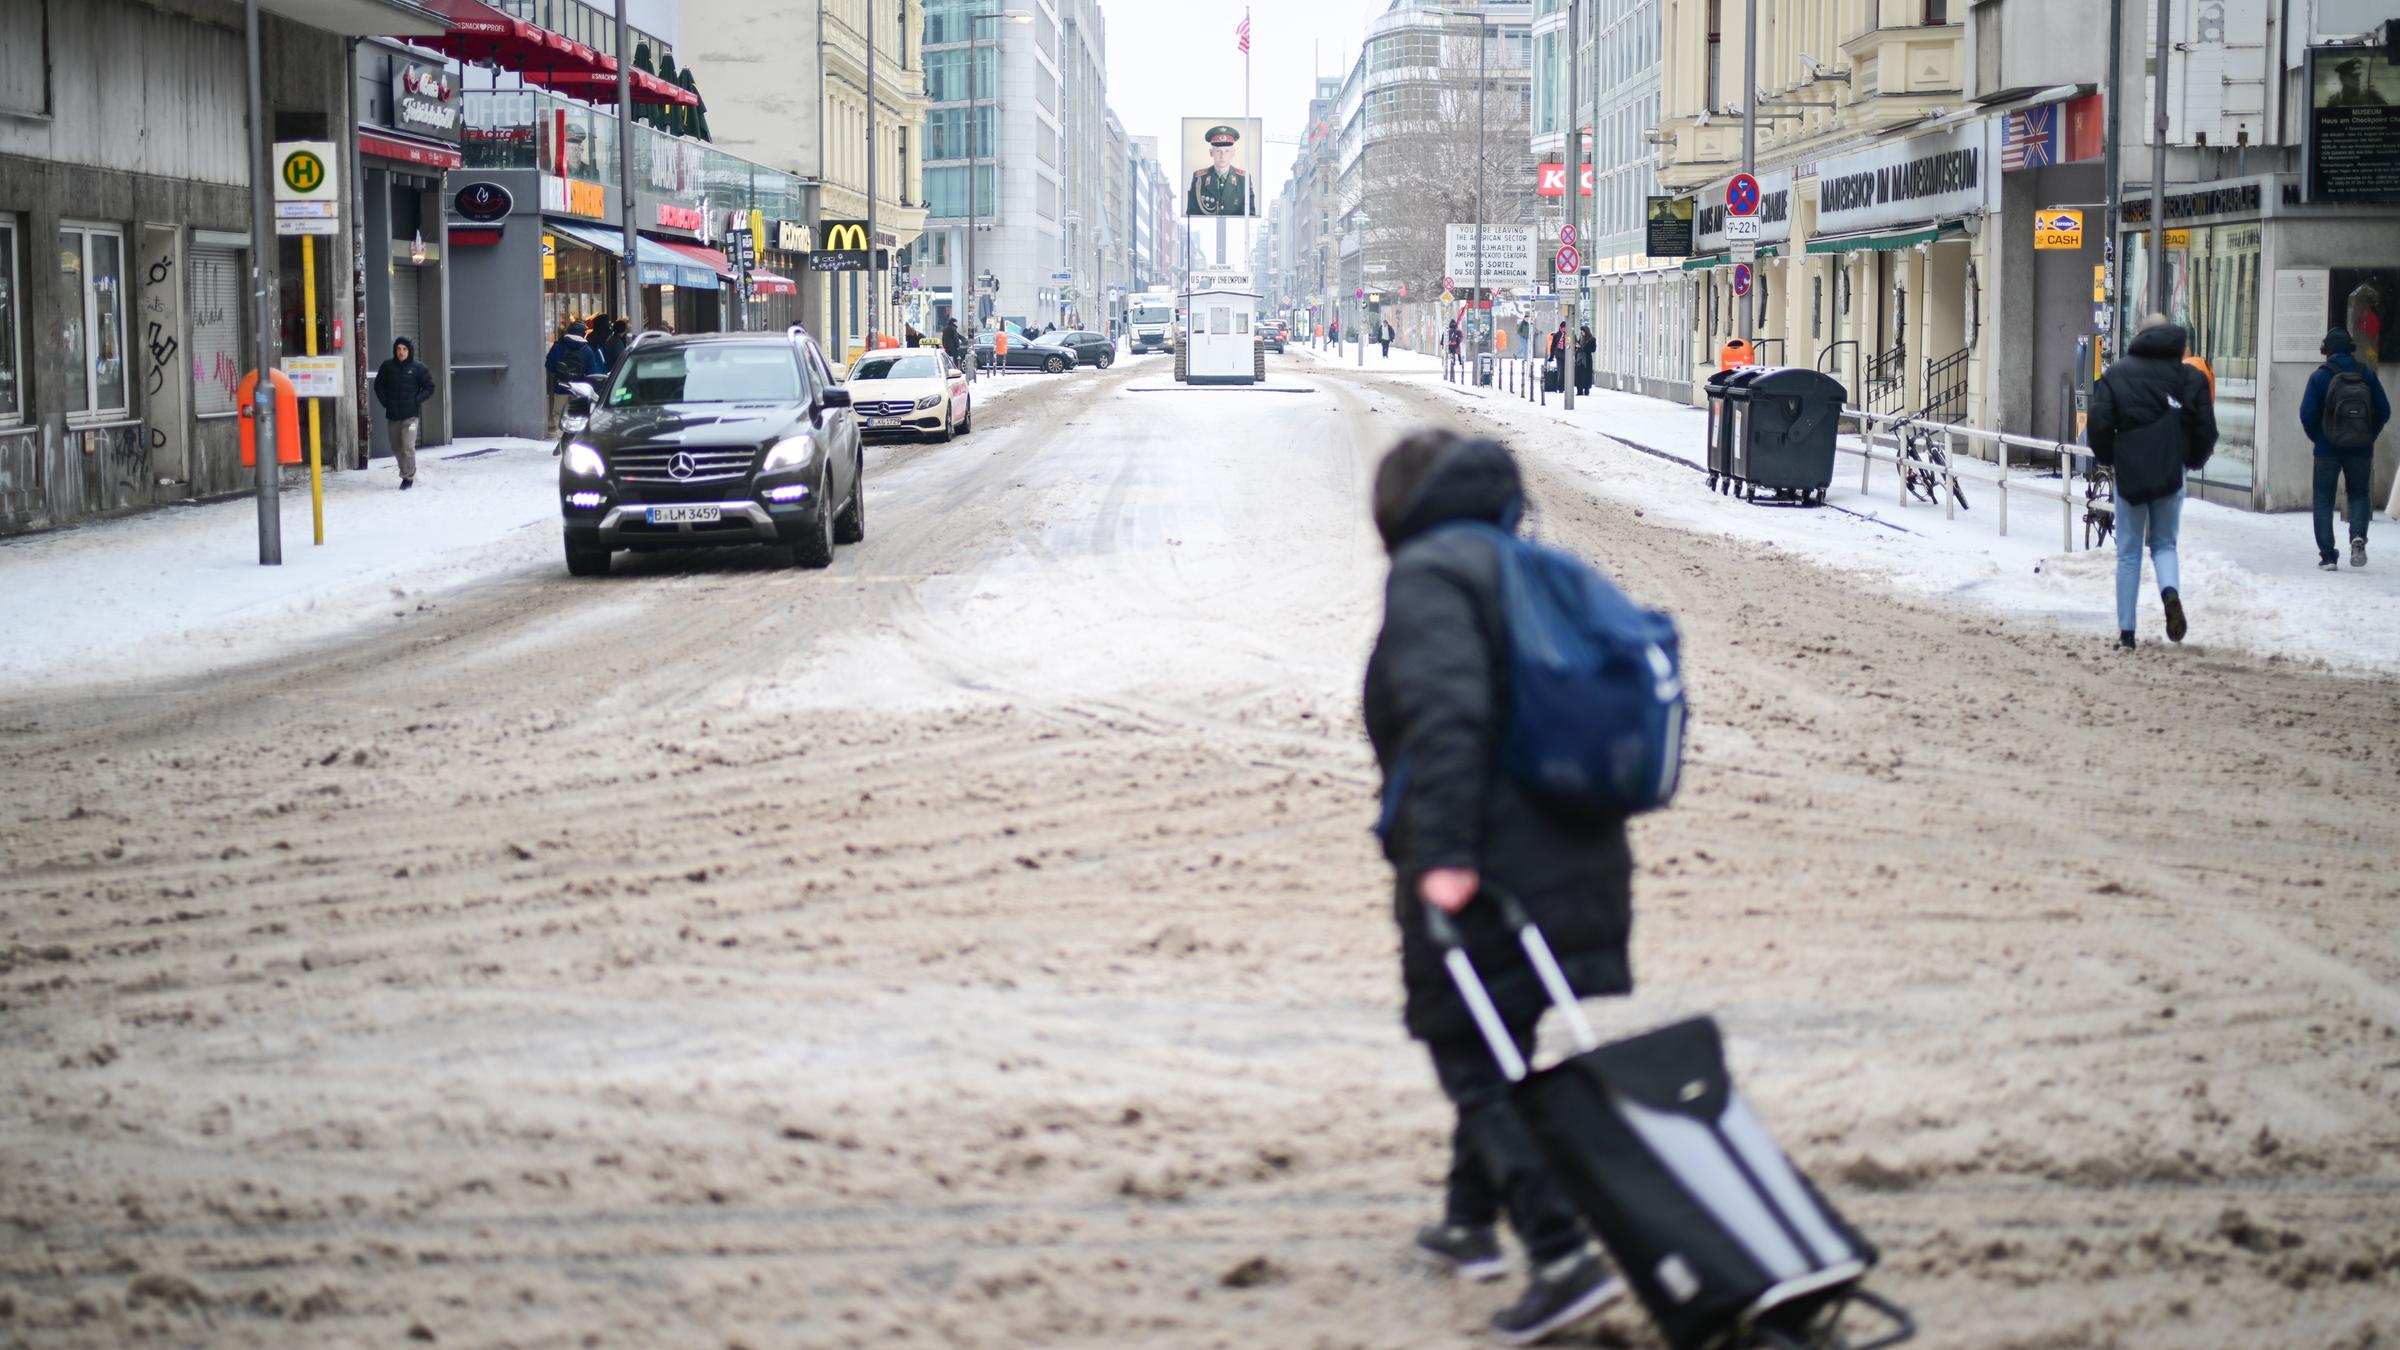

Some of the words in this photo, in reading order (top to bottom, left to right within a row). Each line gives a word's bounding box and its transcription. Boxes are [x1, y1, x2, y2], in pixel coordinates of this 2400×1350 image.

[293, 160, 314, 183] H
[1543, 170, 1592, 188] KC
[1821, 171, 1875, 214] MAUERSHOP
[1877, 166, 1890, 205] IM
[1892, 147, 1978, 202] MAUERMUSEUM
[1760, 190, 1788, 224] CHARLIE
[2163, 192, 2211, 218] HECKPOINT
[1752, 222, 1757, 233] h
[2047, 235, 2079, 245] CASH
[1217, 275, 1249, 284] CHECKPOINT
[1558, 278, 1573, 286] 9-22
[654, 509, 662, 521] B
[669, 508, 686, 521] LM
[688, 507, 718, 520] 3459
